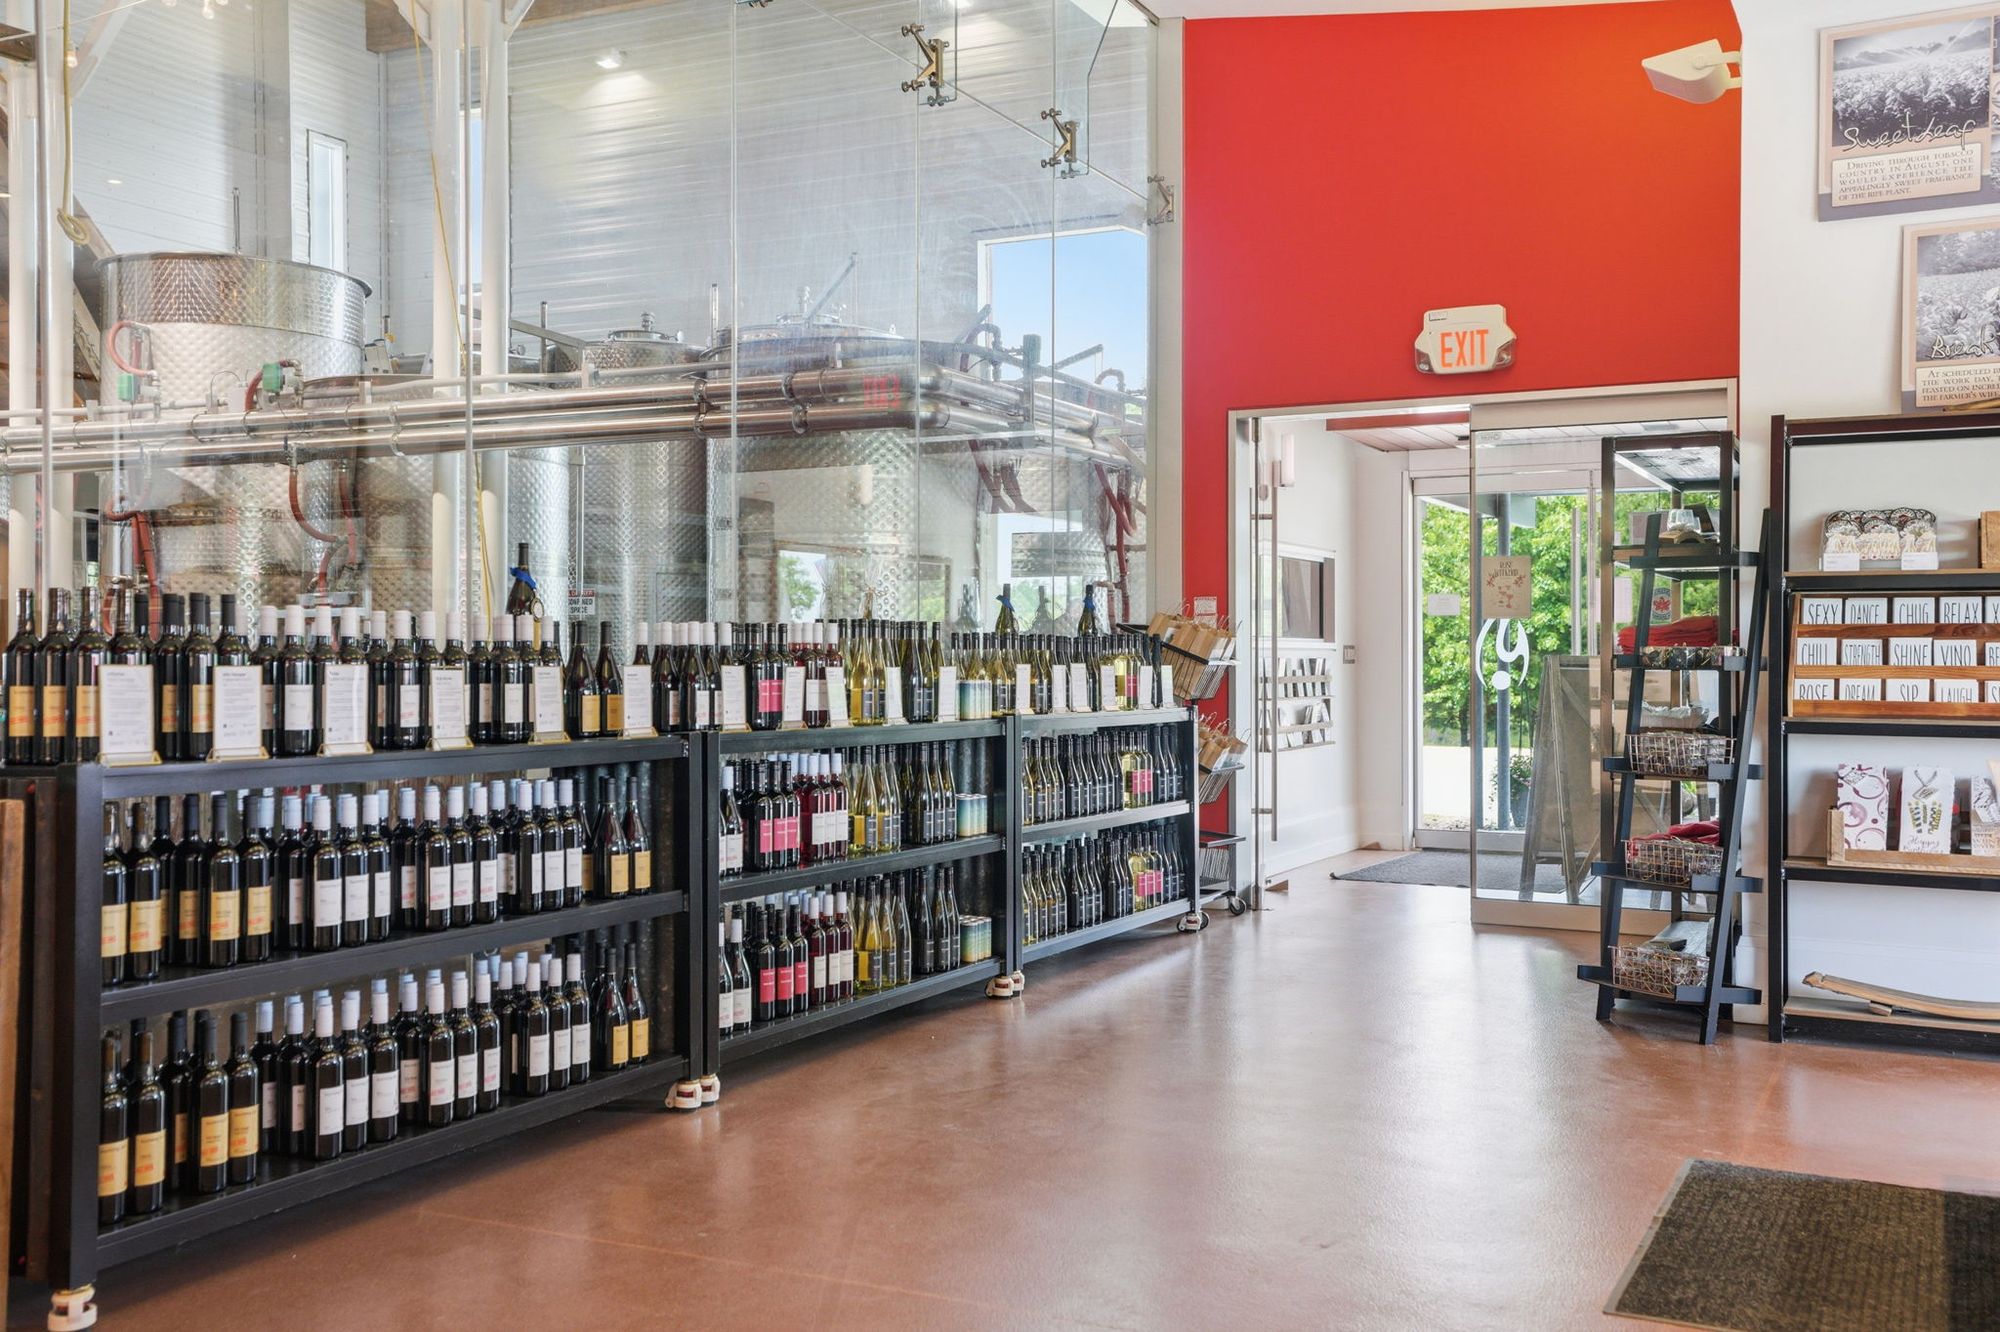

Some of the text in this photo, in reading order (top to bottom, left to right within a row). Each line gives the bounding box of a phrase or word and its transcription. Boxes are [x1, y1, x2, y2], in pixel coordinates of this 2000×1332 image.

[1842, 111, 1976, 151] Sweet Leaf
[1839, 166, 1886, 178] COUNTRY
[1890, 165, 1901, 173] IN
[1952, 157, 1974, 165] ONE
[1839, 164, 1974, 186] WOULD EXPERIENCE THE
[1894, 178, 1923, 187] SWEET
[1440, 329, 1489, 368] EXIT
[1943, 377, 1970, 385] WORK
[1807, 603, 1839, 624] SEXY
[1850, 604, 1880, 624] DANCE
[1899, 603, 1929, 624] CHUG
[1943, 602, 1979, 624] RELAX
[1844, 643, 1881, 665] STRENGTH
[1892, 643, 1928, 666] SHINE
[1940, 644, 1972, 666] VINO
[1844, 684, 1876, 700] DREAM
[1899, 684, 1919, 701] SIP
[1940, 687, 1973, 703] LAUGH
